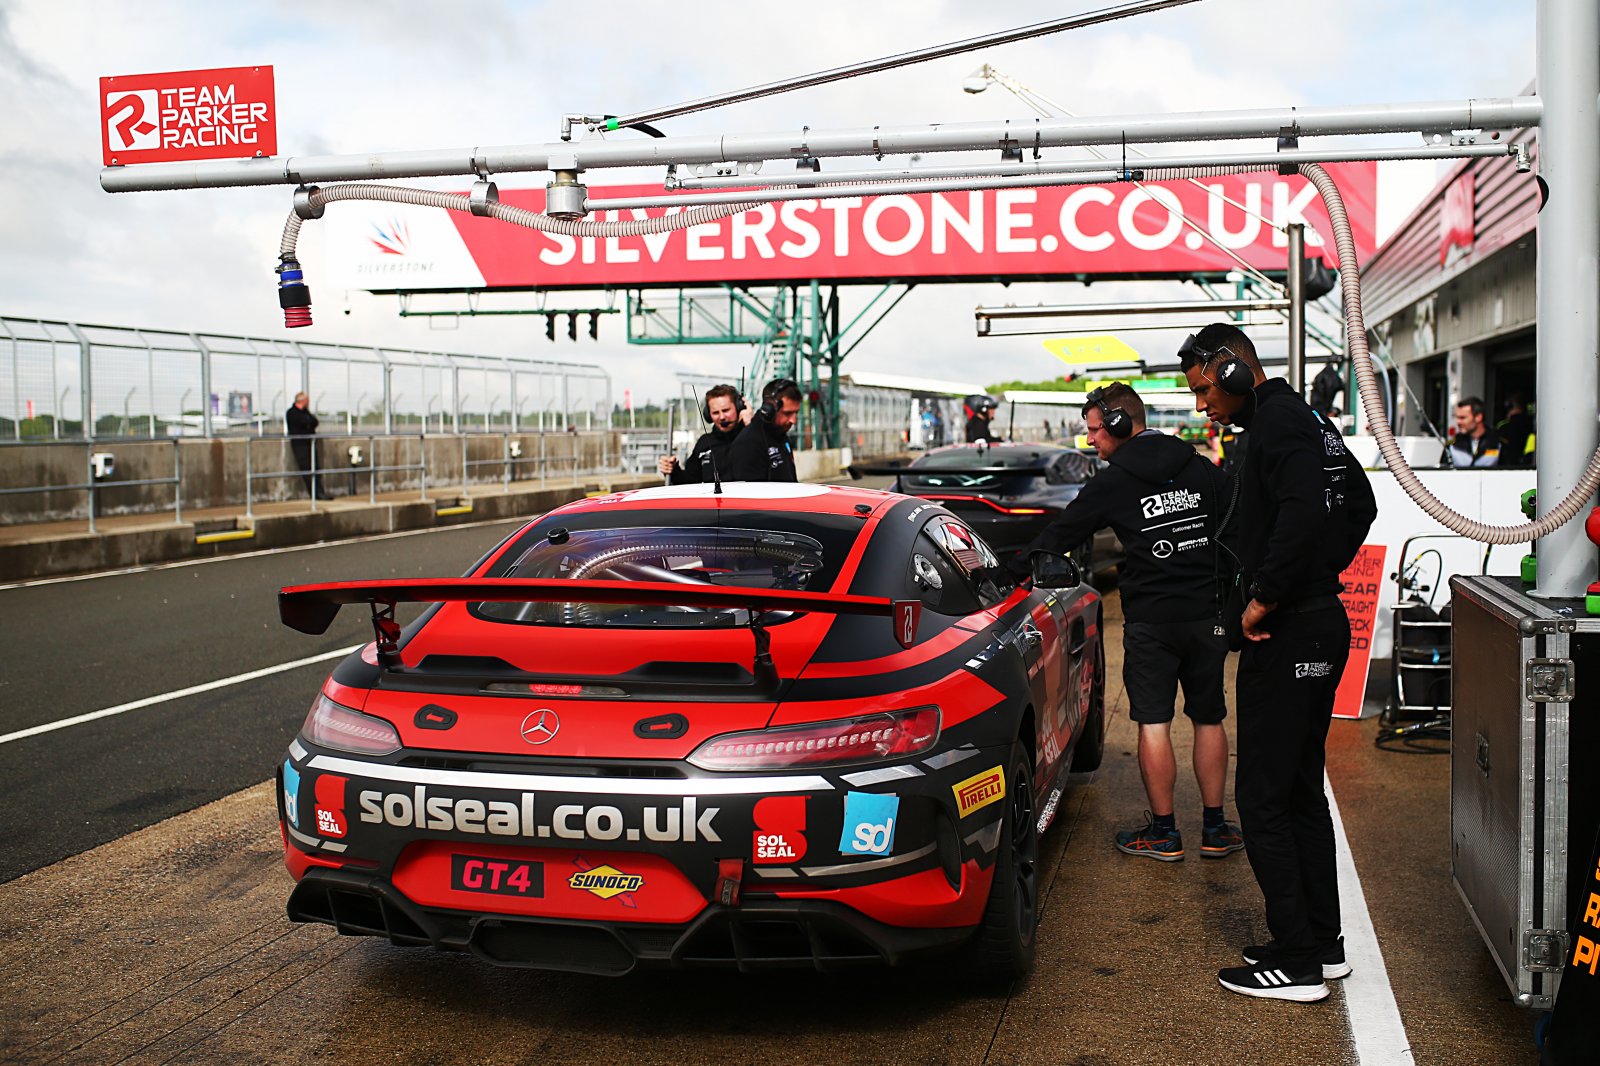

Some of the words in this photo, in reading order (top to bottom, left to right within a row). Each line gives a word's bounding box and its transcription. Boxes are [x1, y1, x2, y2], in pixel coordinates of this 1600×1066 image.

[161, 84, 235, 108] TEAM
[162, 102, 268, 129] PARKER
[163, 123, 257, 149] RACING
[538, 181, 1326, 266] SILVERSTONE.CO.UK
[1161, 488, 1188, 501] TEAM
[1163, 493, 1201, 508] PARKER
[1165, 500, 1199, 514] RACING
[1344, 582, 1377, 597] EAR
[958, 773, 1001, 811] PIRELLI
[317, 809, 335, 822] SOL
[359, 785, 723, 842] solseal.co.uk
[319, 821, 342, 834] SEAL
[852, 817, 893, 853] sd
[757, 835, 787, 846] SOL
[757, 846, 795, 858] SEAL
[463, 859, 531, 892] GT4
[571, 873, 641, 892] SUNOCO
